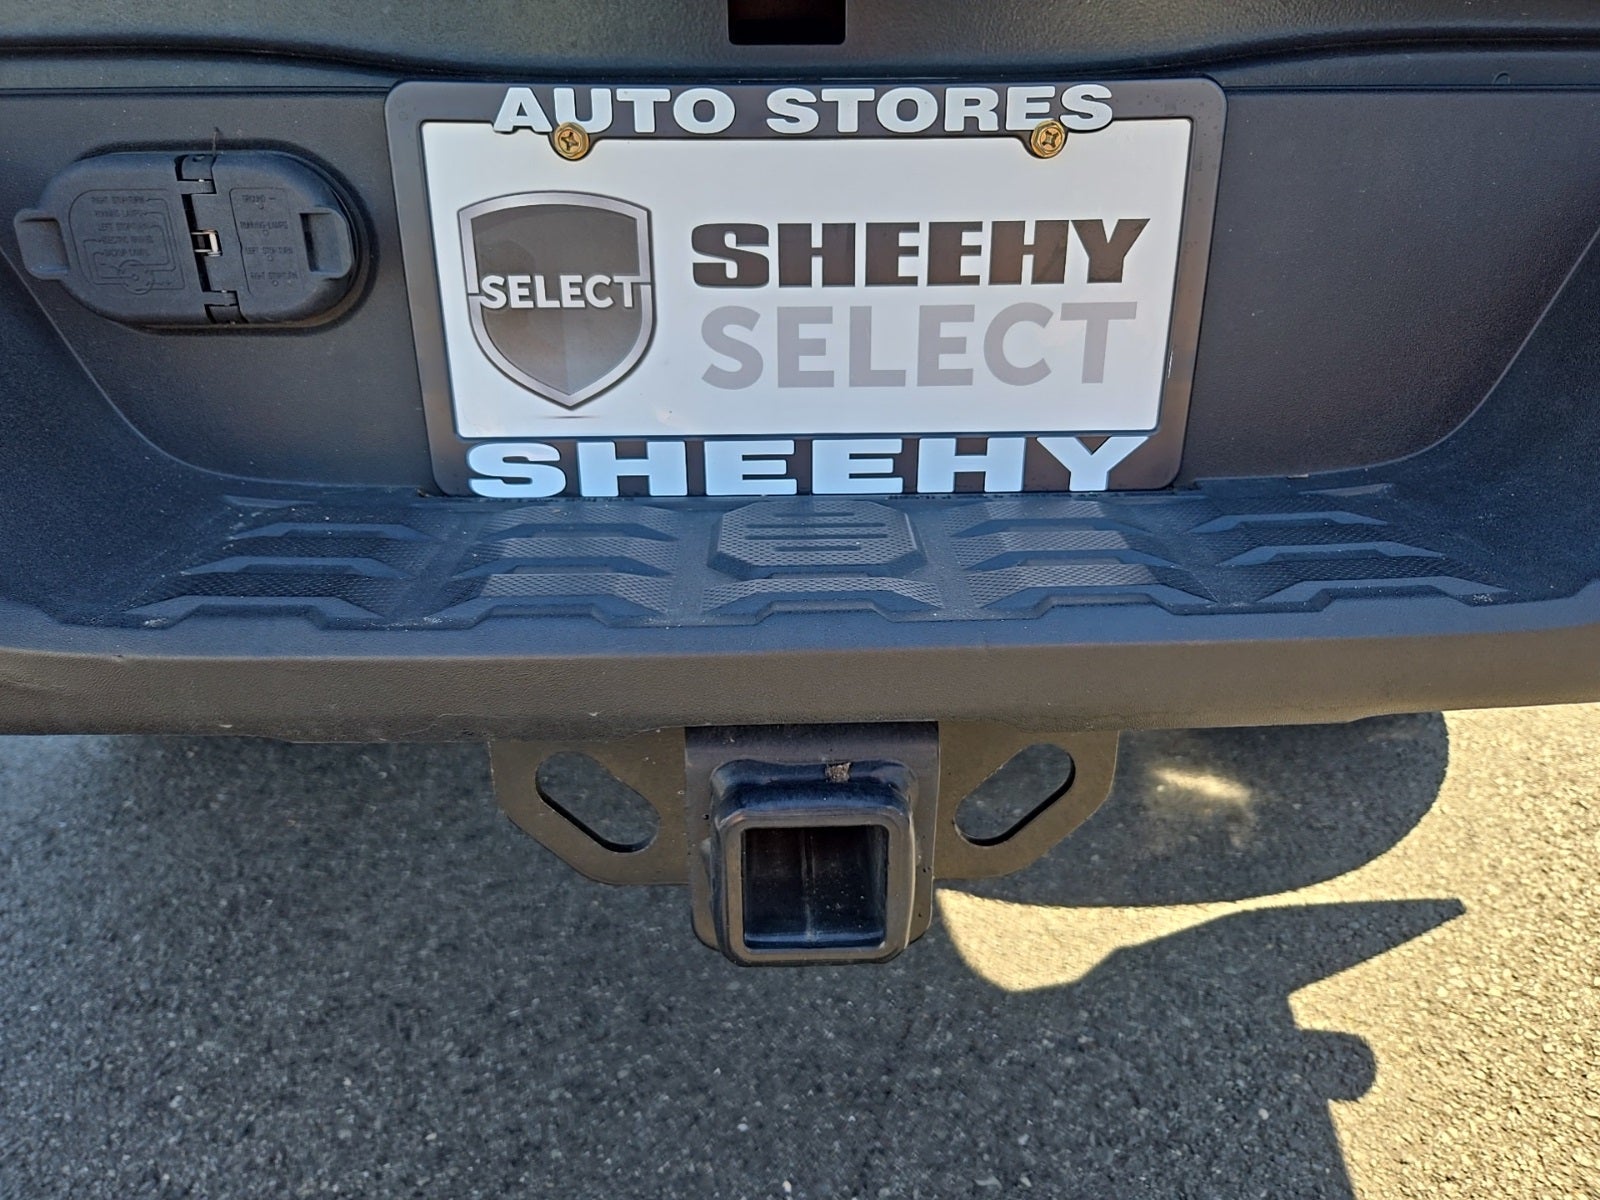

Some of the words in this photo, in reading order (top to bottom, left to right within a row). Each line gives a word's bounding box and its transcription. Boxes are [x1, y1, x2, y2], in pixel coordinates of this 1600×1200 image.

[493, 86, 736, 134] AUTO
[766, 84, 1113, 133] STORES
[692, 218, 1150, 288] SHEEHY
[480, 274, 636, 310] SELECT
[701, 302, 1137, 389] SELECT
[467, 435, 1149, 498] SHEEHY
